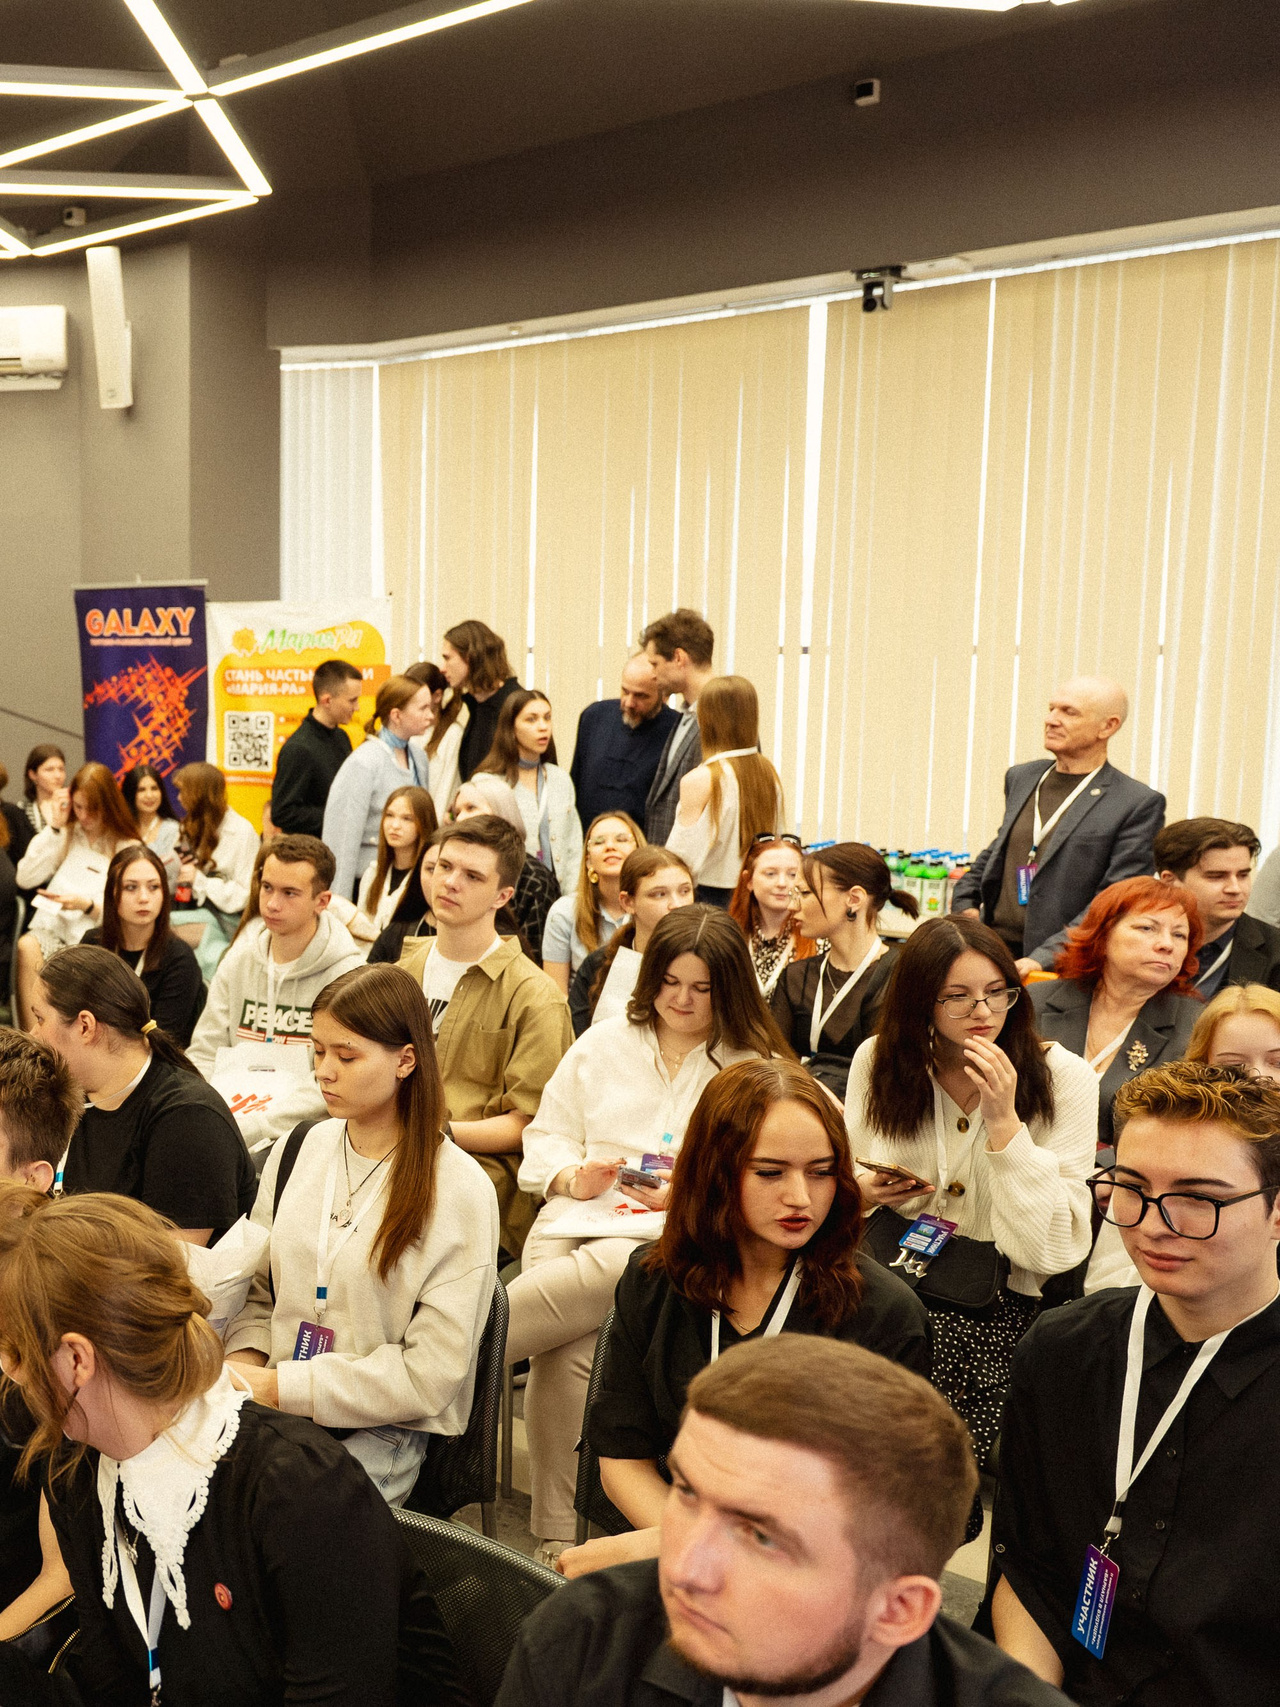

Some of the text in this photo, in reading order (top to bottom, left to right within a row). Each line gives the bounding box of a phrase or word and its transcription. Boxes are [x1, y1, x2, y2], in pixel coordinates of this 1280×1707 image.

[84, 606, 197, 637] GALAXY
[266, 668, 316, 681] ЧАСТЬ
[242, 1003, 313, 1034] PEACE
[298, 1329, 312, 1361] ТНИК
[1076, 1556, 1099, 1635] УЧАСТНИК
